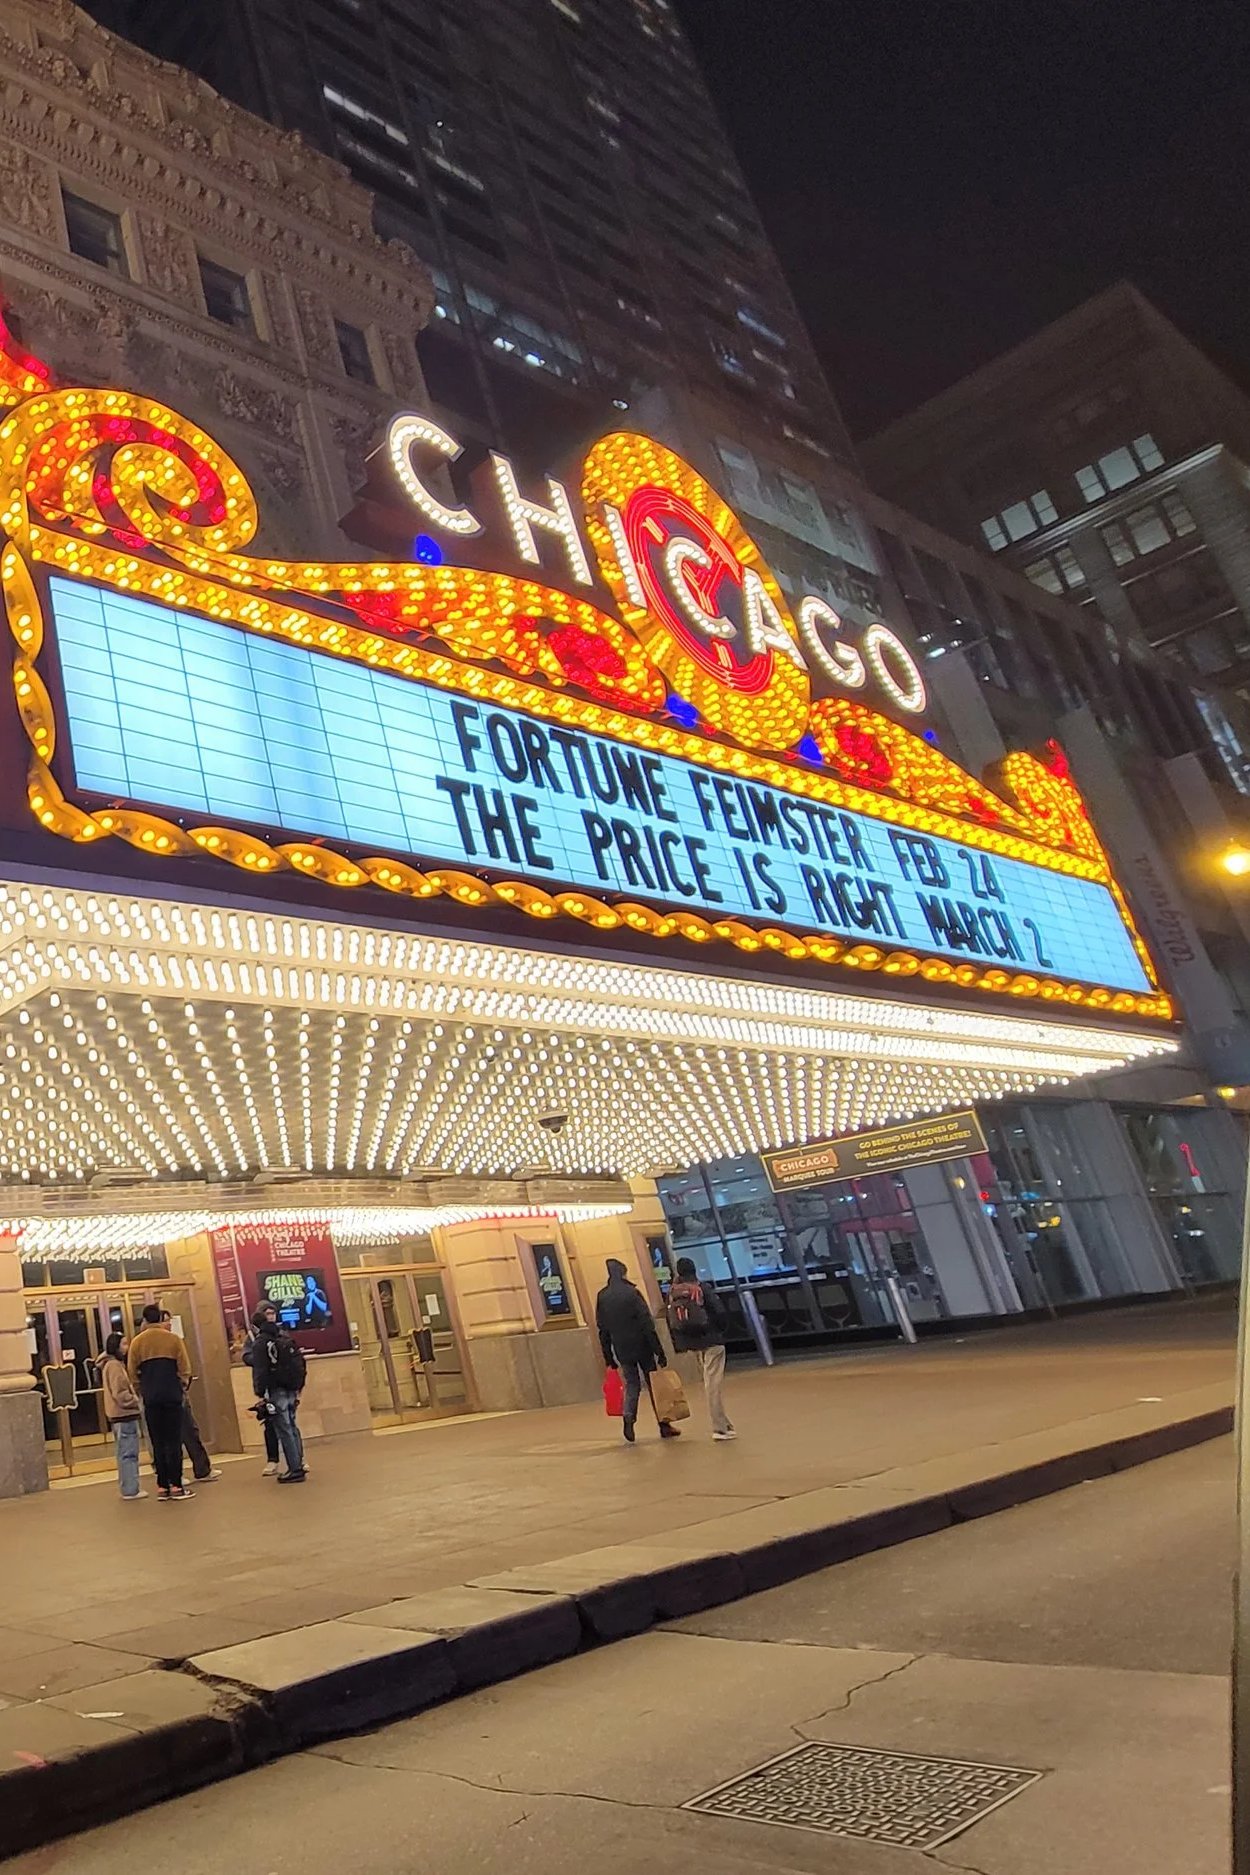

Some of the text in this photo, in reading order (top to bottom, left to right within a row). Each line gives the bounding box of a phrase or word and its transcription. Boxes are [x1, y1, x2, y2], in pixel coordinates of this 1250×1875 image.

[388, 412, 926, 713] CHICAGO
[450, 699, 1006, 904] FORTUNE FEIMSTER FEB 24
[435, 774, 1054, 970] THE PRICE IS RIGHT MARCH 2
[859, 1122, 959, 1149] GO BEHIND THE SCENES OF
[854, 1151, 870, 1160] THE
[870, 1146, 898, 1157] ICONIC
[898, 1138, 934, 1151] CHICAGO
[780, 1155, 829, 1172] CHICAGO
[264, 1273, 306, 1290] SHANE
[268, 1286, 306, 1302] GILLIS
